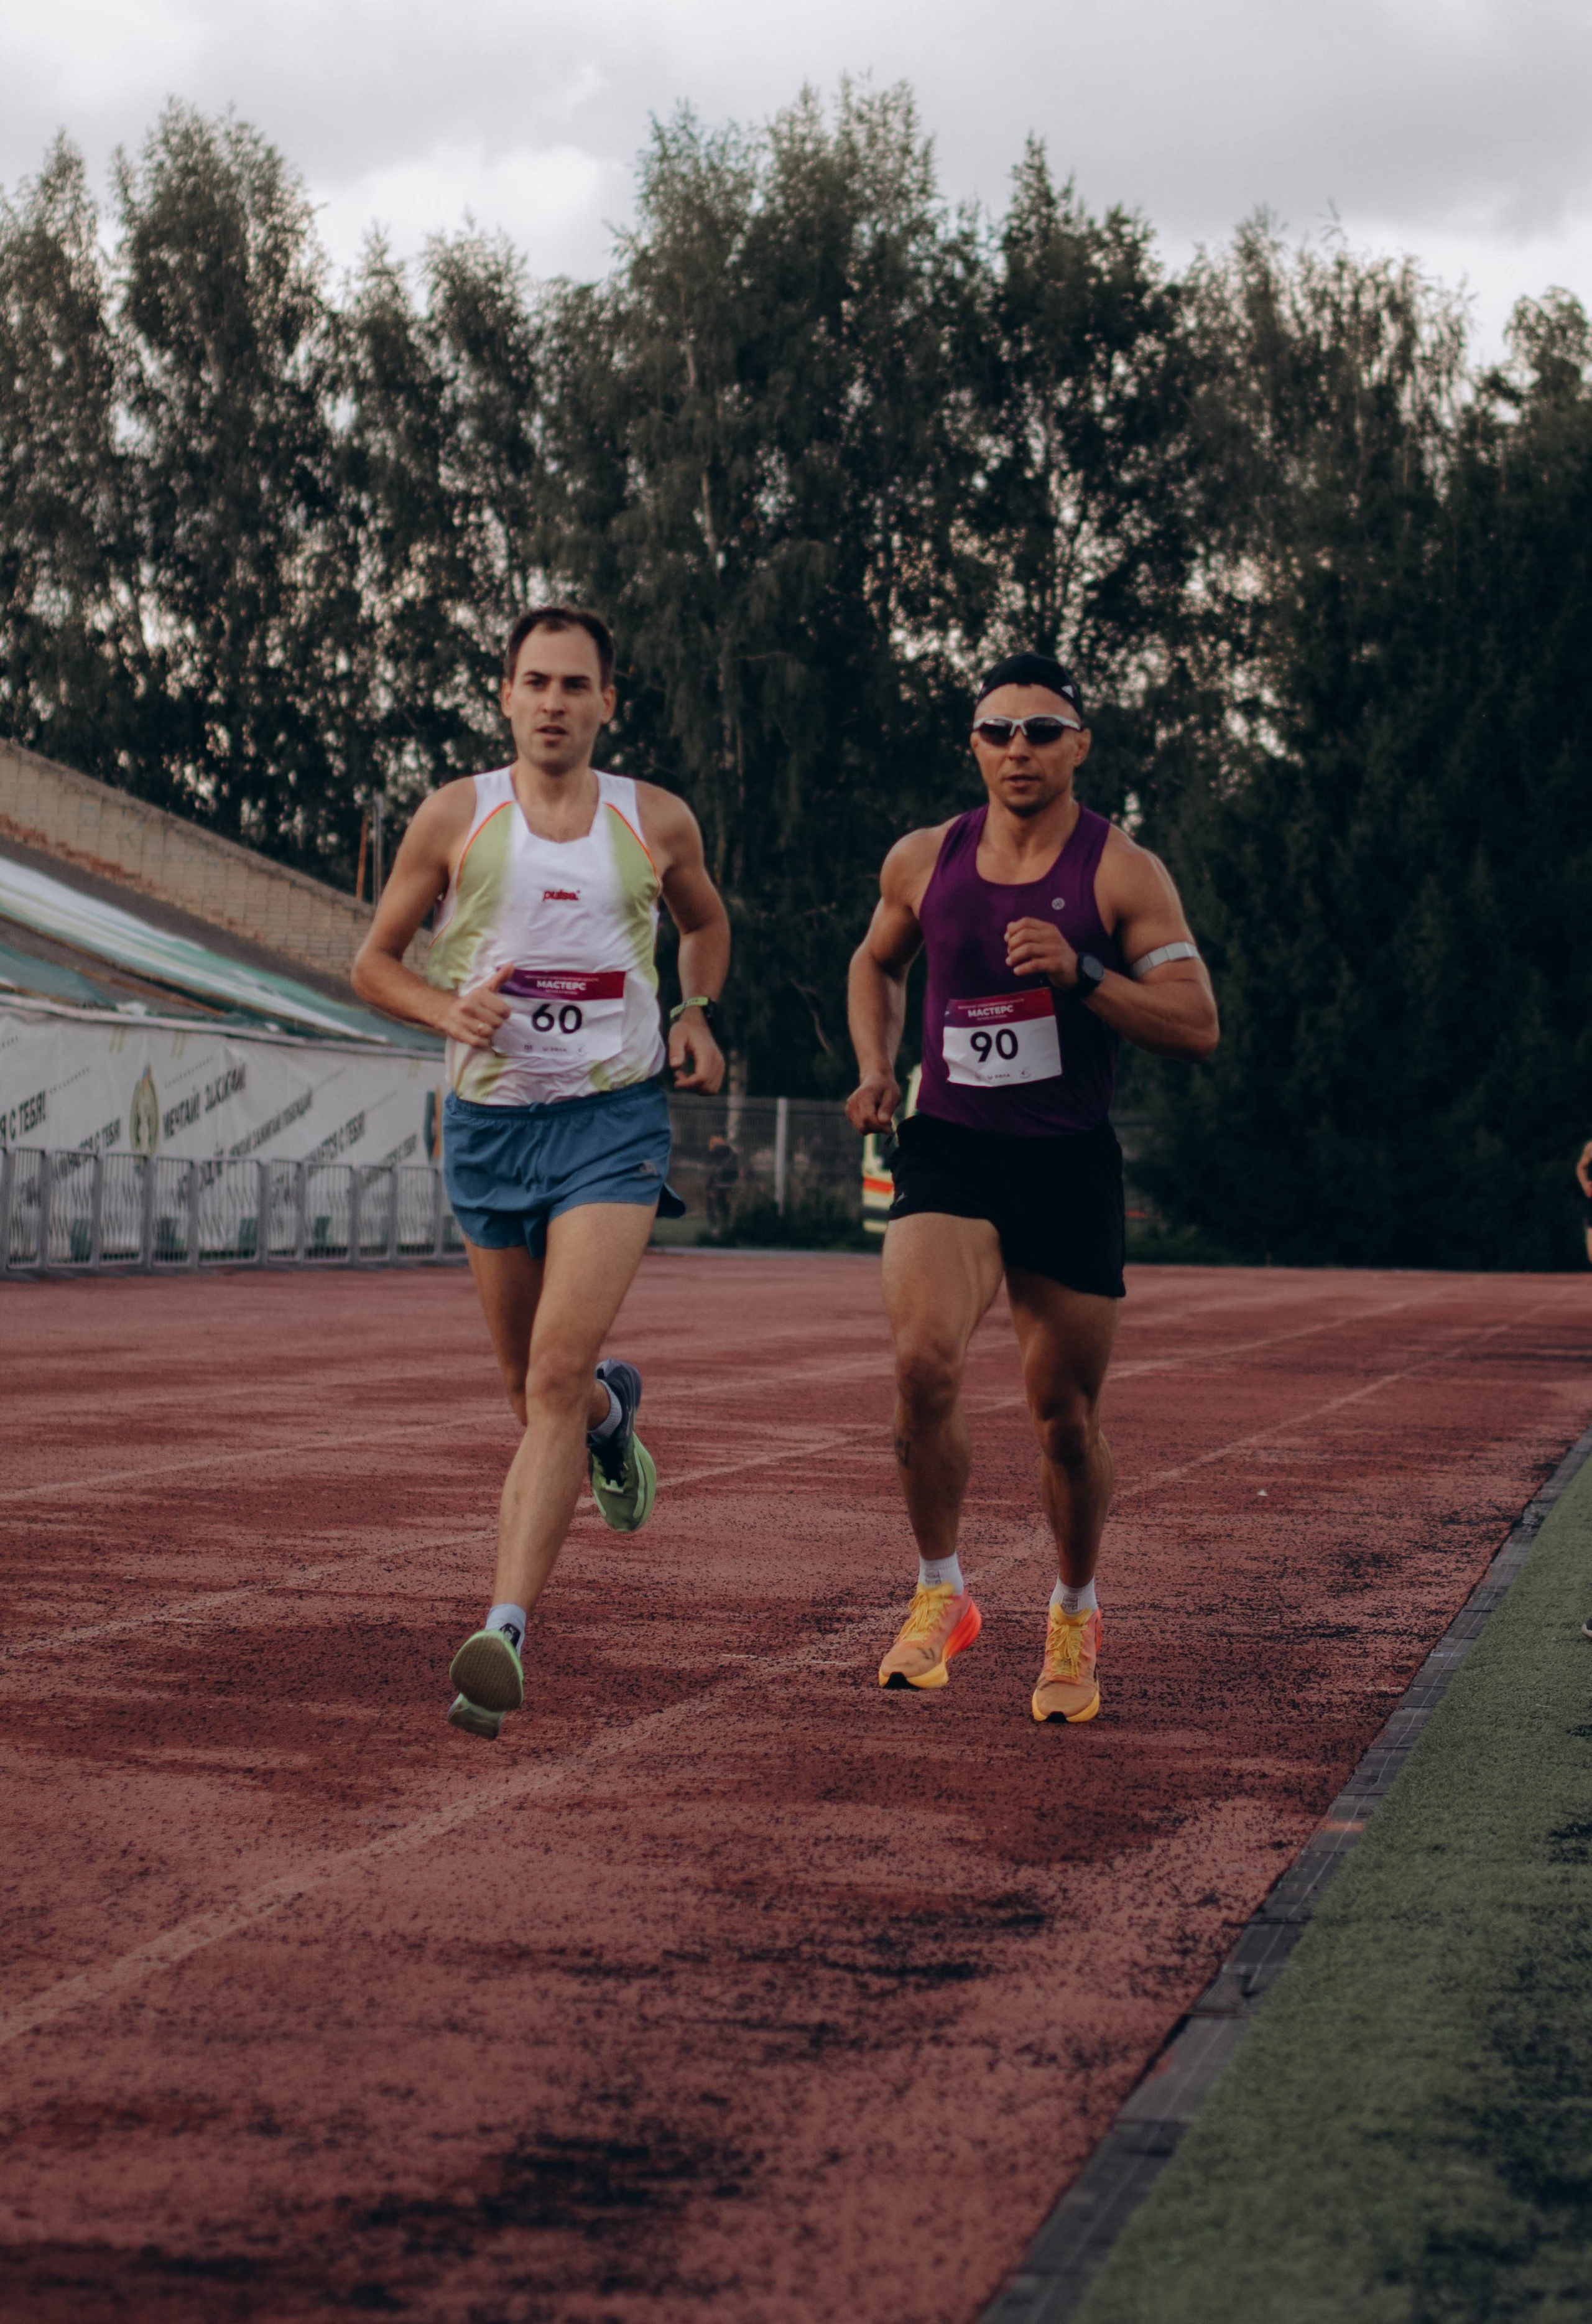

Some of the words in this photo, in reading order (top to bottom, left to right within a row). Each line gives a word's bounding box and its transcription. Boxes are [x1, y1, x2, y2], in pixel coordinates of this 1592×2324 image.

[537, 980, 586, 991] МАСТЕРС
[532, 1003, 583, 1034] 60
[968, 1004, 1014, 1017] МАСТЕРС
[970, 1028, 1018, 1062] 90
